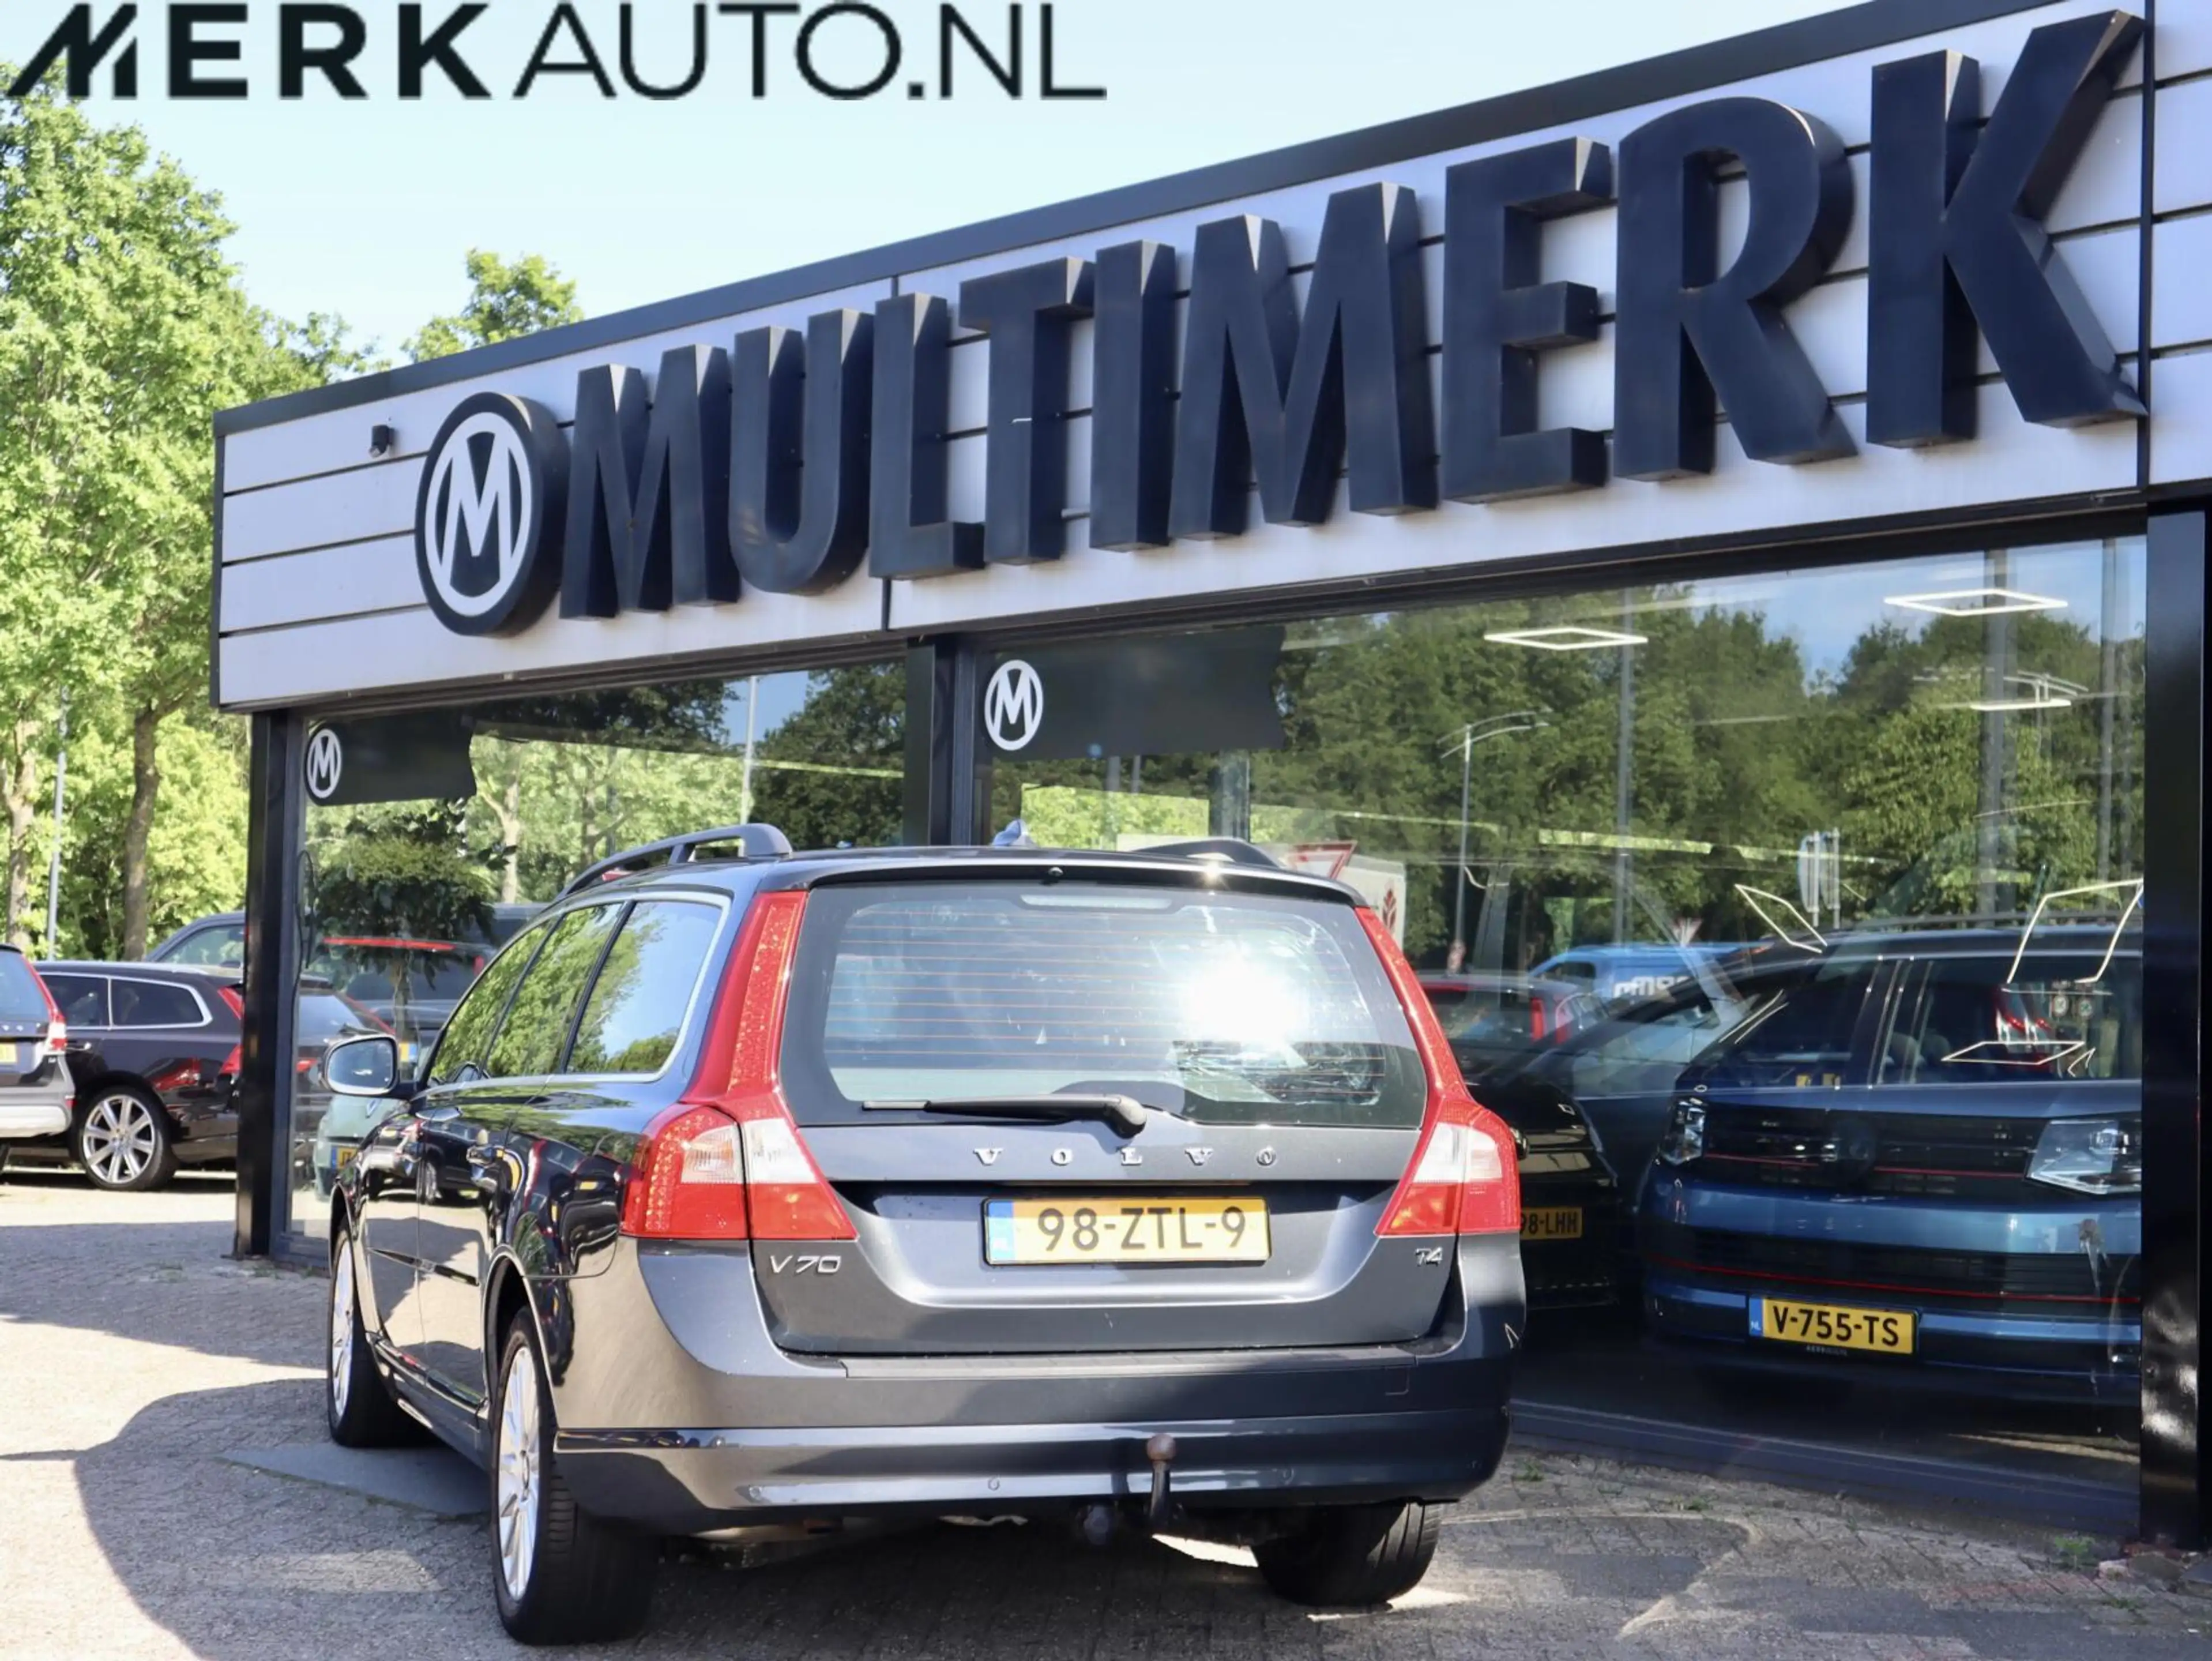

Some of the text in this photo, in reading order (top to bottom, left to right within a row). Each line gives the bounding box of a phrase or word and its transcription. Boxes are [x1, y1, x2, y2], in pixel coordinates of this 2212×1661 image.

[559, 10, 2148, 621] MULTIMERK
[974, 1145, 1277, 1166] VOLVO
[1038, 1205, 1246, 1252] 98-ZTL-9
[1415, 1247, 1443, 1267] T4
[1773, 1305, 1899, 1347] V-755-TS
